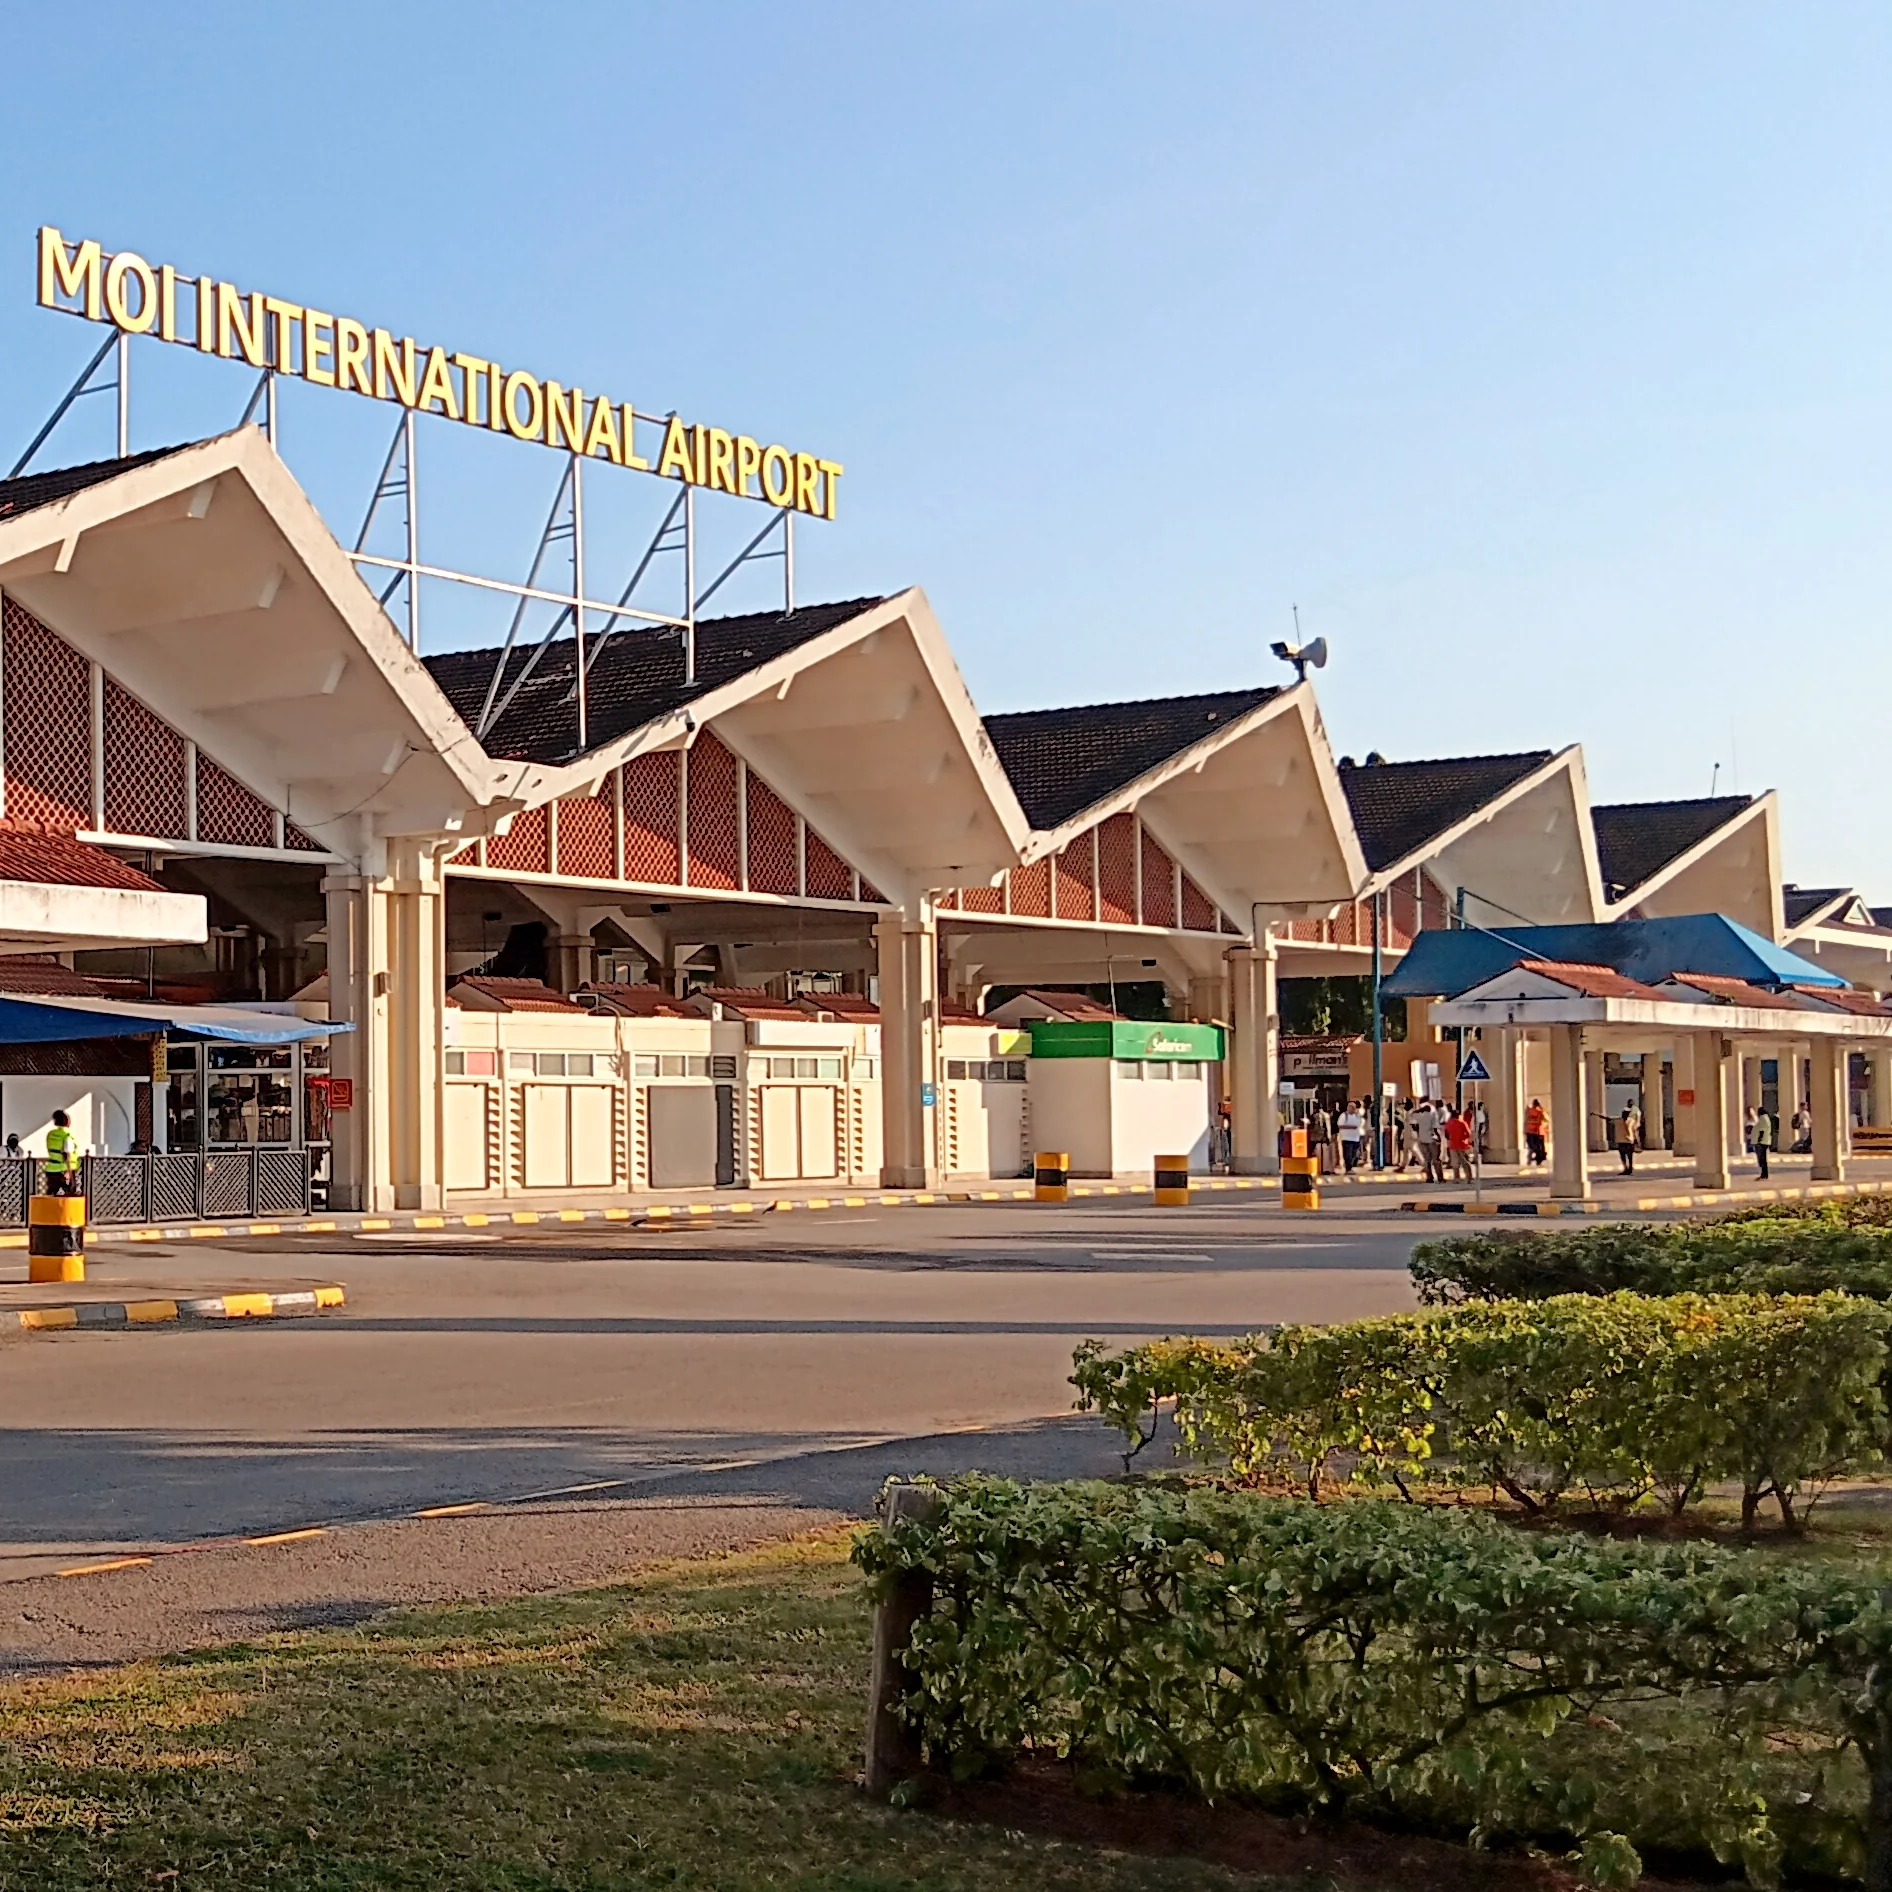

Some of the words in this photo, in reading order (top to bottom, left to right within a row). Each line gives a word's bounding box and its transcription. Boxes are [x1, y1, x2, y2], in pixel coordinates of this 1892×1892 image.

[38, 226, 174, 342] MOI
[196, 276, 648, 471] INTERNATIONAL
[657, 416, 844, 521] AIRPORT
